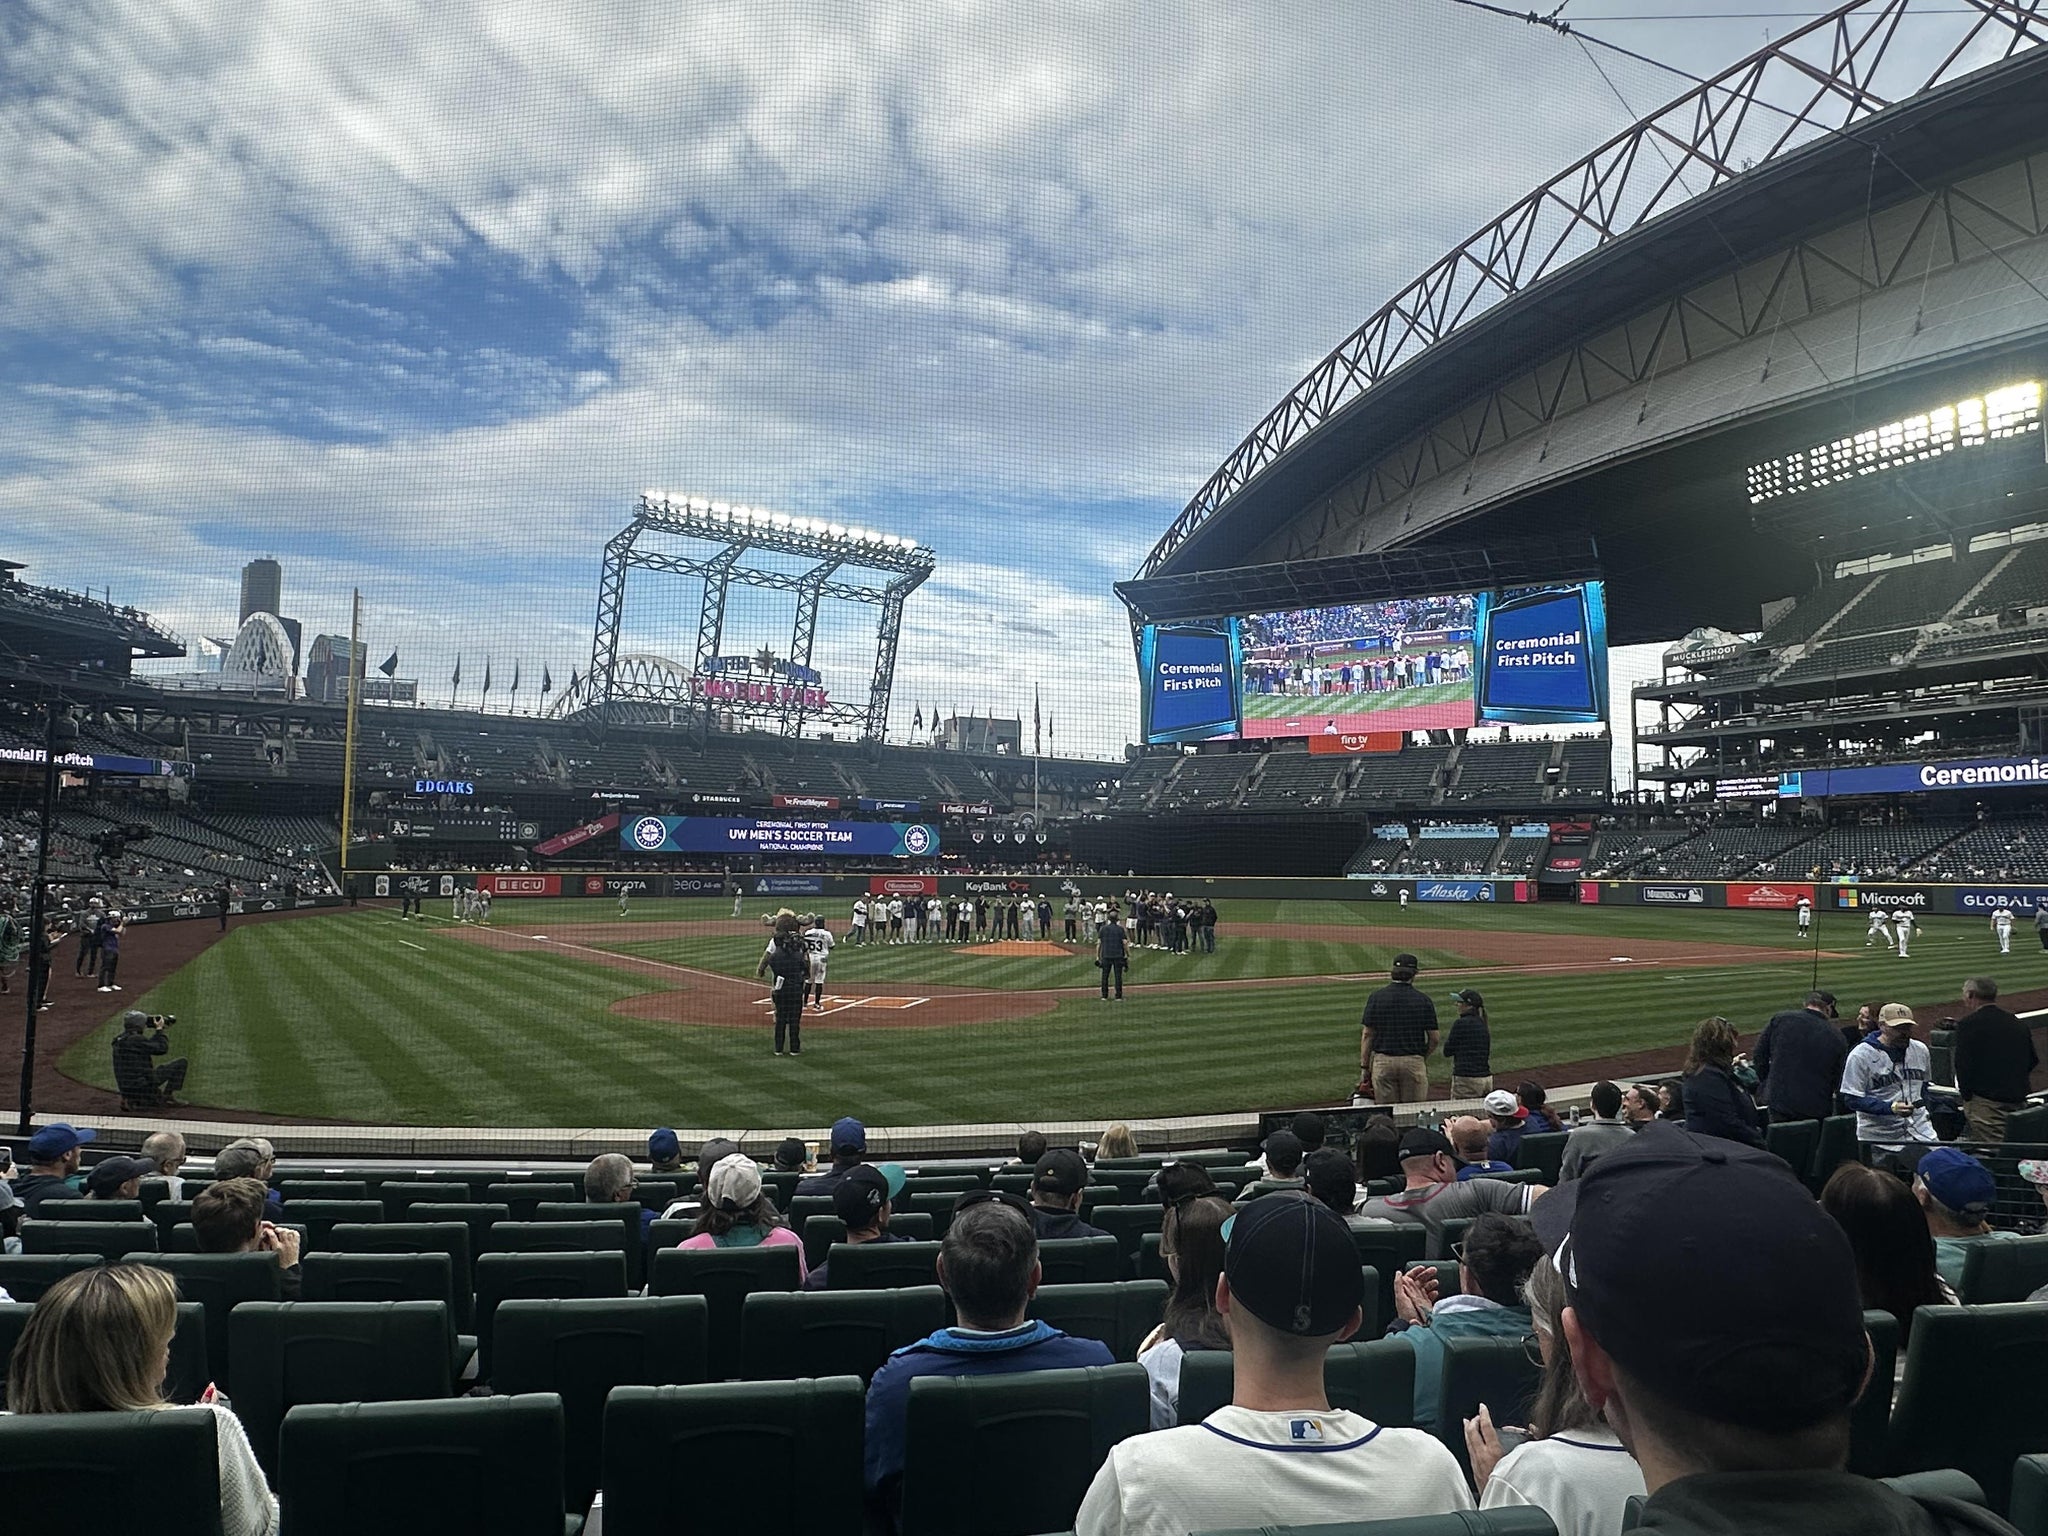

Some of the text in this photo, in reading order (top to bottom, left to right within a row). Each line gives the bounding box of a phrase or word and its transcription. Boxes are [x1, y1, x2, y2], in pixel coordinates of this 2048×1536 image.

[1495, 631, 1580, 651] Ceremonial
[1498, 651, 1576, 667] First Pitch
[1672, 645, 1737, 662] MUCKLESHOOT
[1159, 662, 1223, 675] Ceremonial
[1163, 676, 1222, 692] First Pitch
[779, 685, 831, 709] PARK
[1341, 735, 1369, 744] fire tv
[64, 752, 94, 767] Pitch
[415, 780, 474, 795] EDGARS
[702, 795, 741, 804] STARBUCKS
[756, 821, 793, 829] CEREMONIAL
[811, 822, 829, 830] PITCH
[729, 829, 853, 842] UW MEN'S SOCCER TEAM
[759, 843, 824, 851] NATIONAL CHAMPIONS
[606, 880, 647, 890] TOYOTA
[674, 879, 701, 890] eero
[965, 881, 1008, 893] KeyBank
[1421, 884, 1469, 899] Alaska
[1861, 893, 1926, 906] Microsoft
[1963, 895, 2033, 907] GLOBAL
